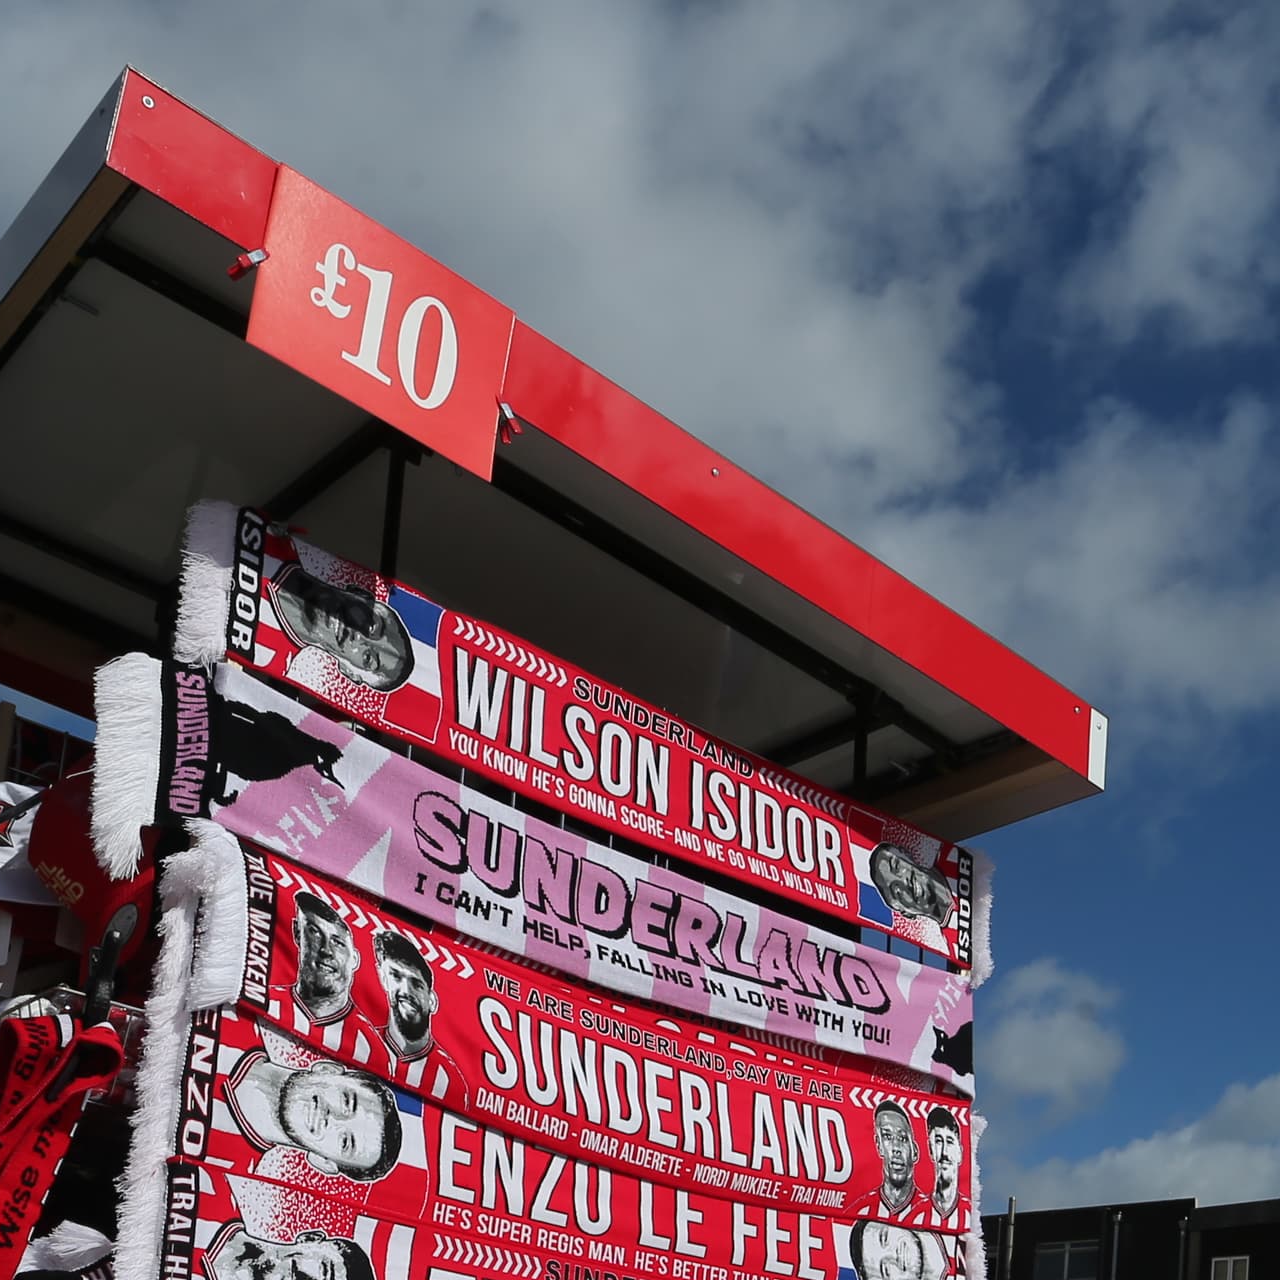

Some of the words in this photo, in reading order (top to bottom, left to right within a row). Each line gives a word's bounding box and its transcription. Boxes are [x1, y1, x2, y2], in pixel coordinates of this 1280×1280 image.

[310, 243, 457, 409] £10
[232, 512, 262, 652] ISIDOR
[170, 671, 209, 815] SUNDERLAND
[455, 646, 669, 816] WILSON
[691, 760, 845, 889] ISIDOR
[572, 676, 754, 778] SUNDERLAND
[448, 727, 478, 760] YOU
[483, 744, 528, 782] KNOW
[532, 764, 564, 798] HE'S
[569, 783, 617, 820] GONNA
[704, 839, 725, 862] WE
[728, 851, 746, 870] GO
[244, 852, 272, 904] TRUE
[413, 790, 891, 1015] SUNDERLAND
[958, 856, 970, 961] ISIDOR
[244, 907, 272, 1004] MACKEM
[415, 873, 427, 895] I
[436, 882, 513, 927] CAN'T
[523, 916, 592, 960] HELP,
[598, 944, 694, 988] FALLING
[703, 977, 726, 998] IN
[735, 987, 789, 1015] LOVE
[796, 1006, 844, 1032] WITH
[852, 1022, 891, 1045] YOU!
[179, 1009, 217, 1157] ENZO
[478, 997, 853, 1185] SUNDERLAND
[484, 968, 520, 1001] WE
[526, 989, 574, 1022] ARE
[734, 1061, 770, 1085] SAY
[774, 1071, 803, 1094] WE
[807, 1081, 844, 1102] ARE
[169, 1172, 197, 1243] TRAI
[438, 1111, 612, 1236] ENZO
[638, 1180, 707, 1258] LE
[731, 1202, 826, 1280] FEE
[476, 1086, 503, 1116] DAN
[506, 1103, 569, 1141] BALLARD
[579, 1128, 618, 1158] OMAR
[622, 1142, 684, 1177] ALDERETE
[692, 1165, 728, 1188] NORDI
[730, 1172, 782, 1197] MUKIELE
[791, 1184, 815, 1205] TRAI
[817, 1190, 846, 1209] HUME
[432, 1201, 472, 1230] HE'S
[476, 1213, 532, 1245] SUPER
[537, 1228, 584, 1258] REGIS
[588, 1240, 628, 1267] MAN.
[634, 1251, 669, 1276] HE'S
